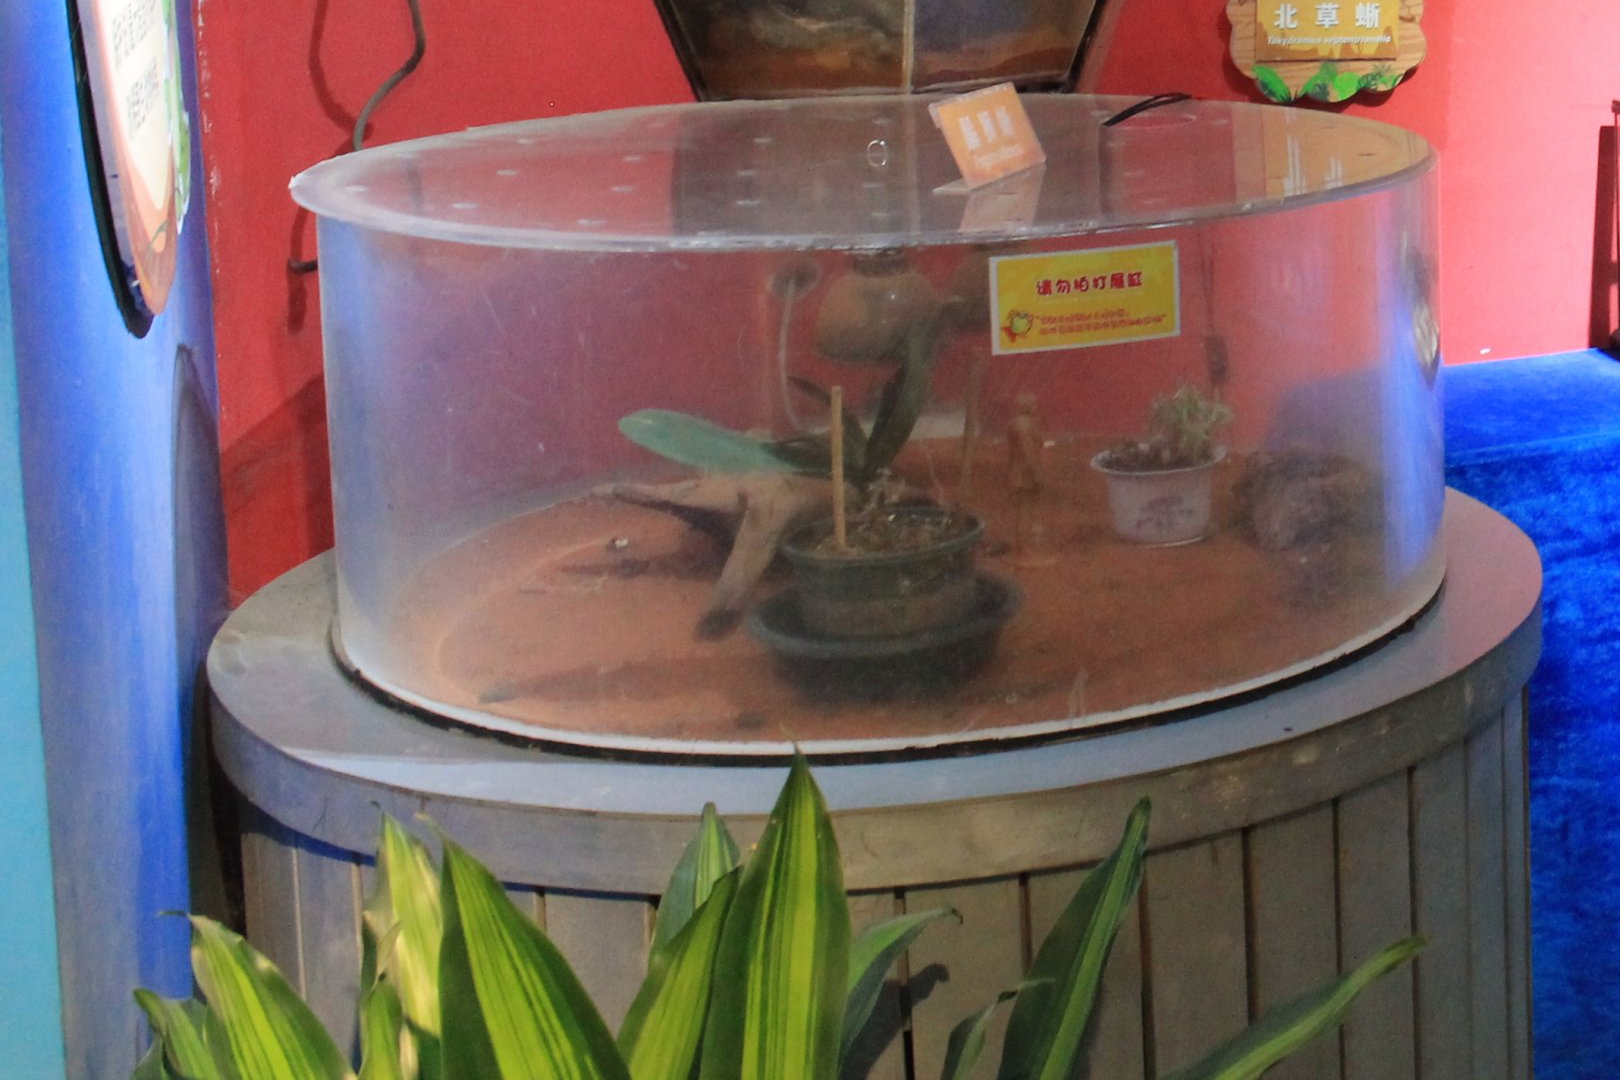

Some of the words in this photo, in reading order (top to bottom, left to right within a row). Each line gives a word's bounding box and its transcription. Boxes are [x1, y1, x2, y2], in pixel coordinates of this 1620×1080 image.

[1274, 2, 1380, 29] 北草蜥
[1035, 271, 1143, 296] 请勿拍打展缸
